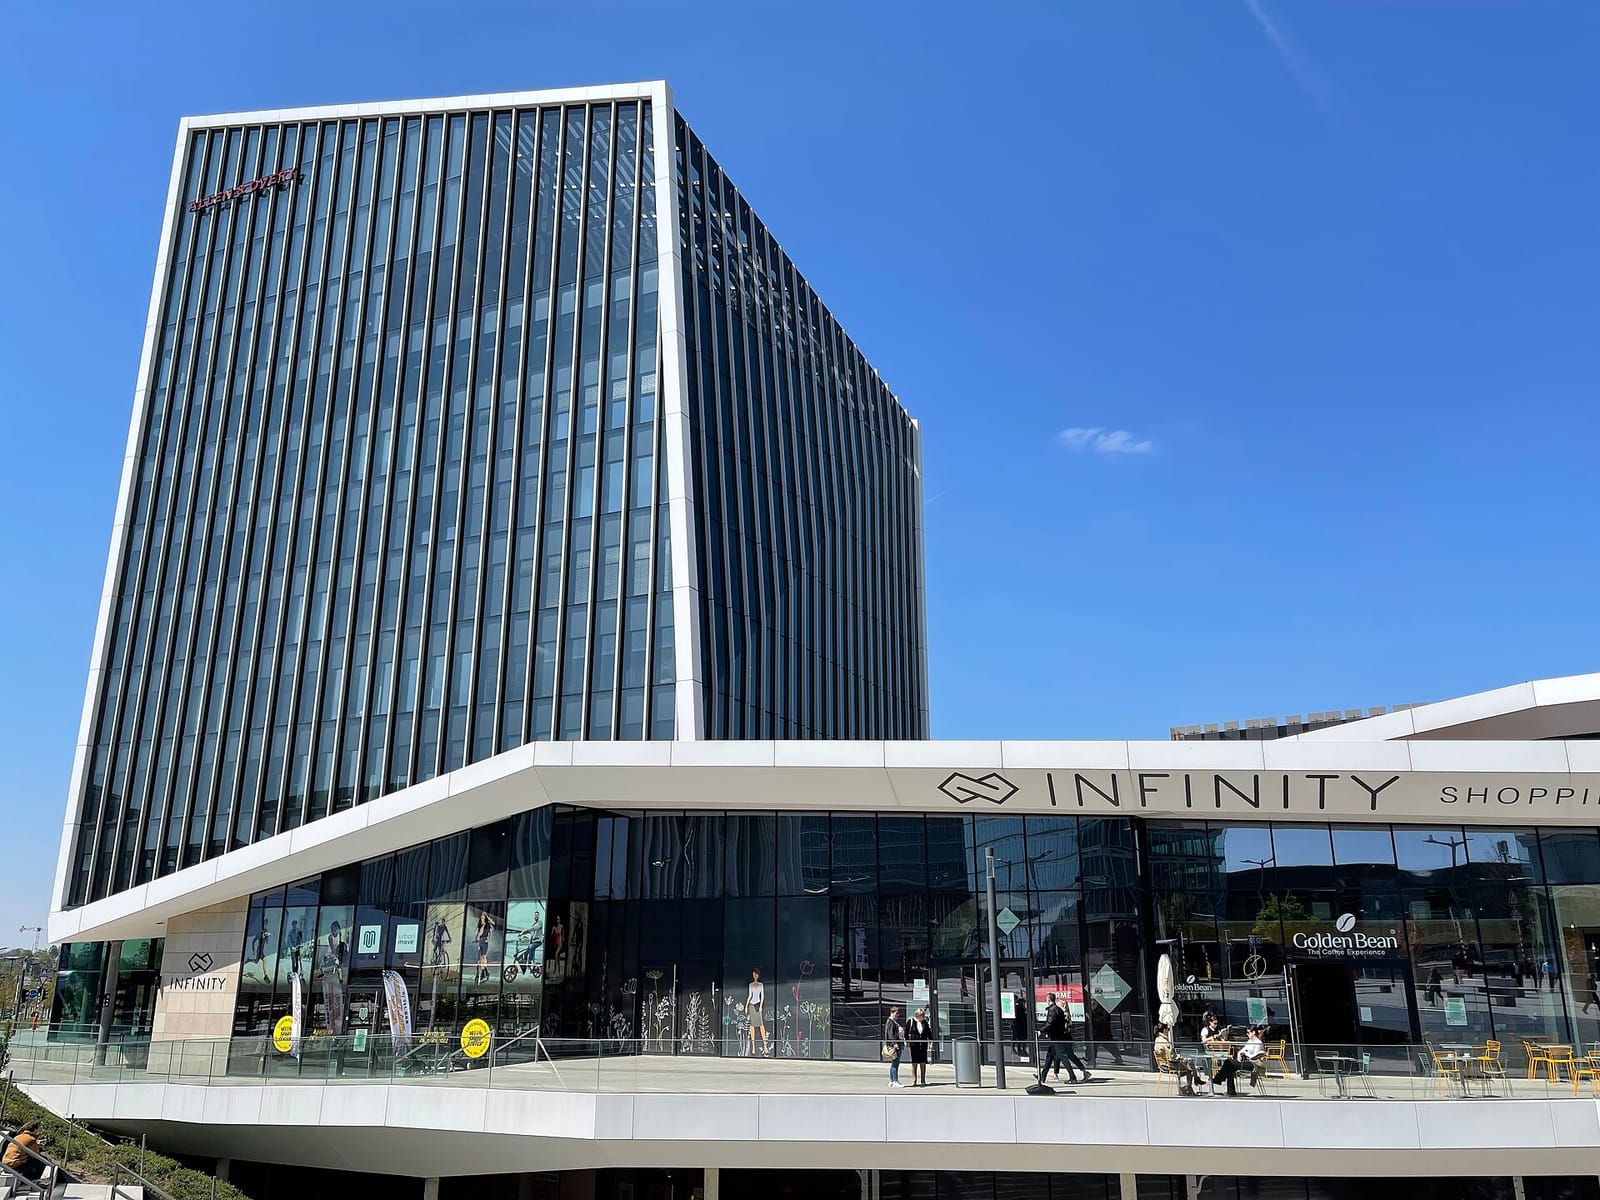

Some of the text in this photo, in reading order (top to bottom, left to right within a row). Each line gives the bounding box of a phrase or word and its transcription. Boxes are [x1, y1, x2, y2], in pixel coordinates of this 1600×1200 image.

[188, 189, 233, 211] ALLEN
[249, 167, 297, 191] OVERY
[1047, 772, 1600, 811] INFINITY SHOPPI
[1292, 932, 1398, 949] Golden Bean
[1346, 948, 1385, 956] Experience
[169, 977, 227, 990] INFINITY
[1174, 983, 1213, 991] olden Bean
